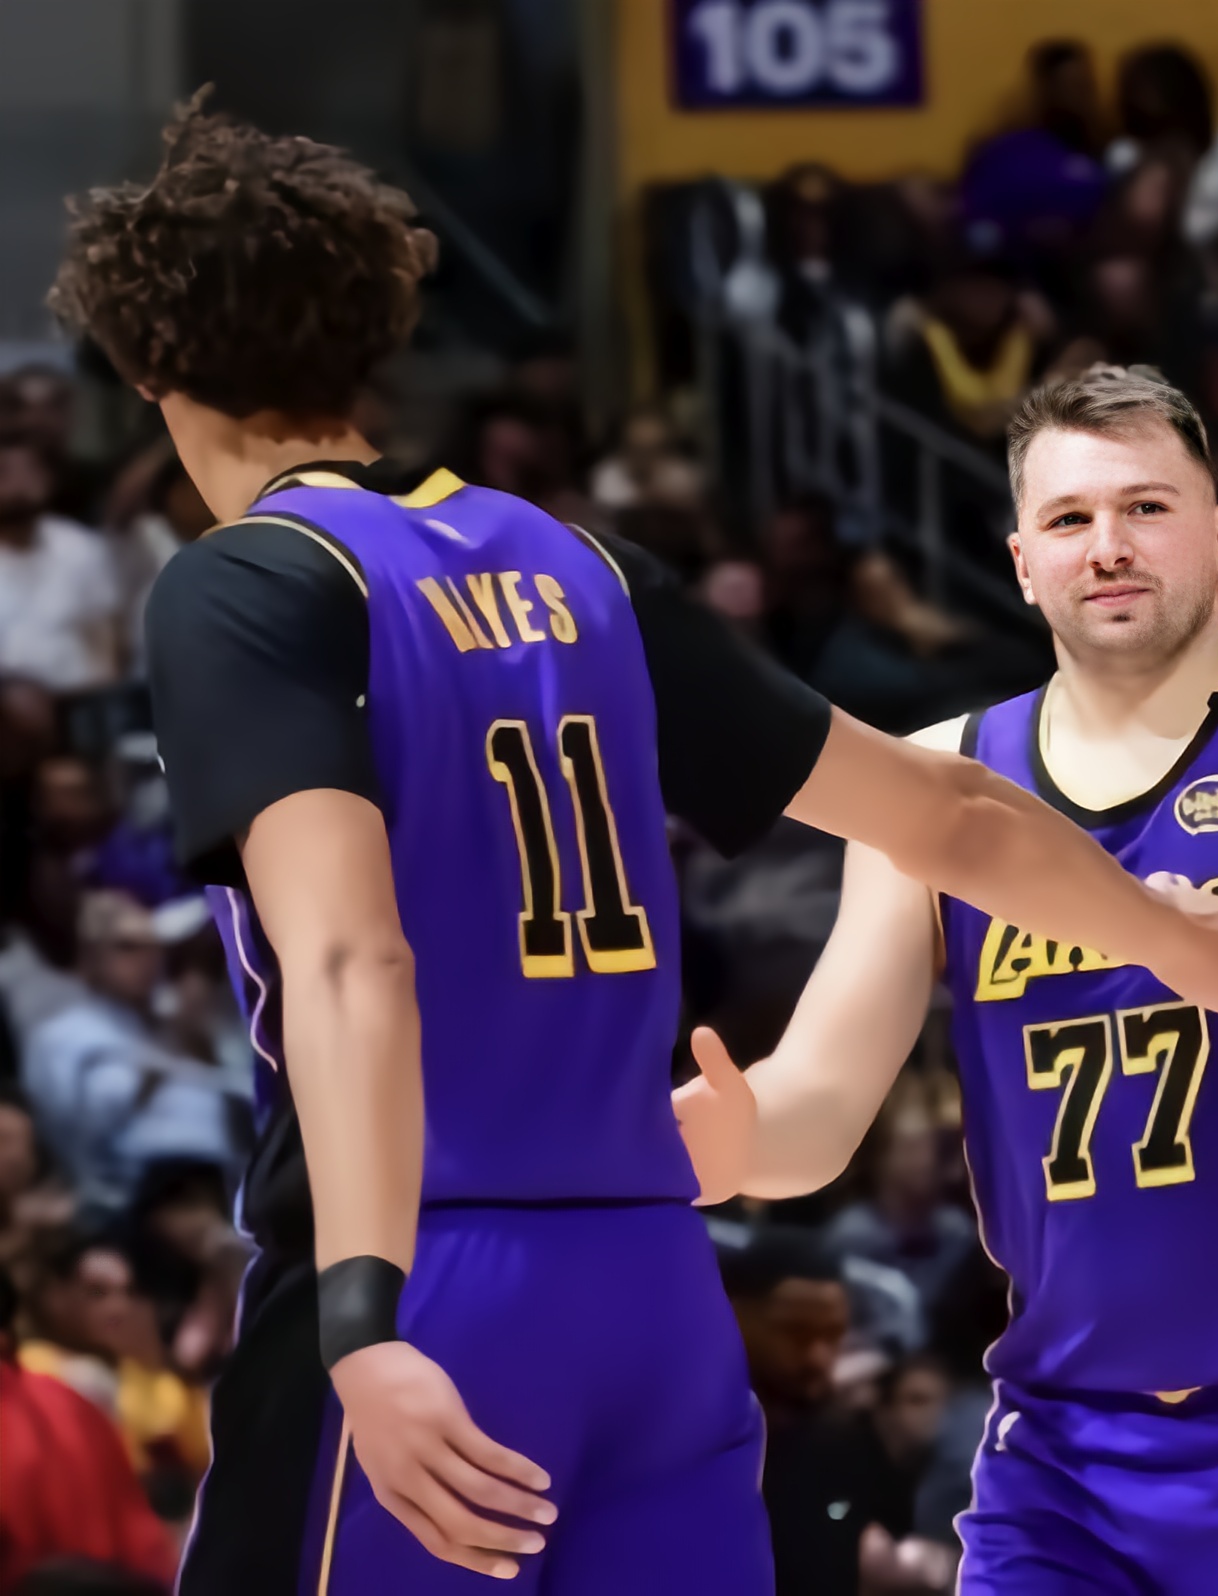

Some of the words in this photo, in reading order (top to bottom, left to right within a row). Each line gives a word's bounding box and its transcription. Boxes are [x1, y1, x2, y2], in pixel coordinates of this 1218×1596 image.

[687, 0, 898, 93] 105
[486, 714, 656, 978] 11
[1022, 1000, 1210, 1200] 77
